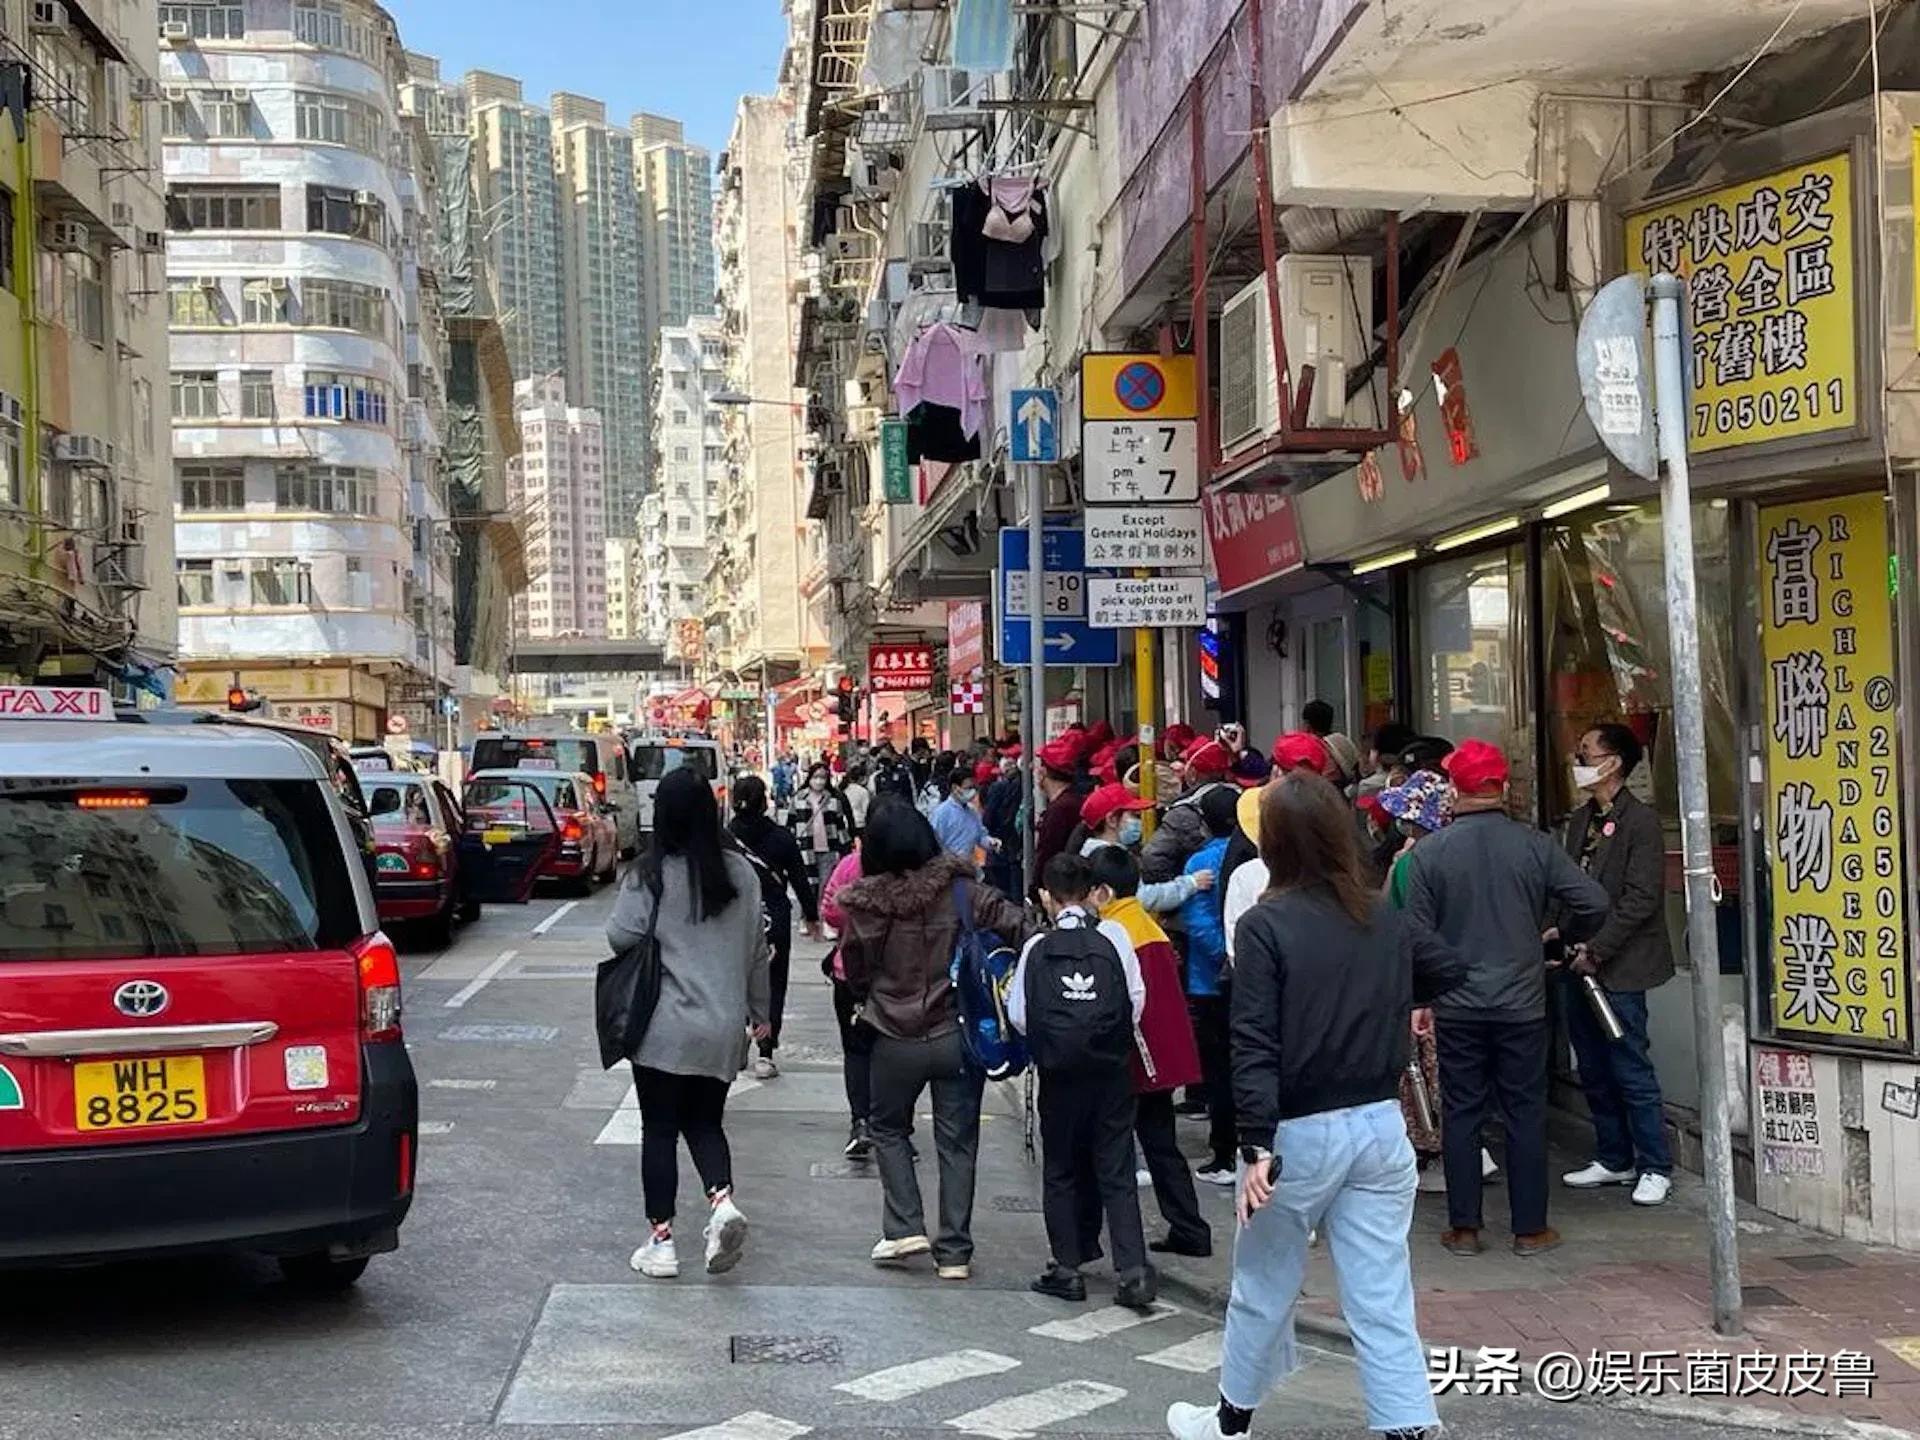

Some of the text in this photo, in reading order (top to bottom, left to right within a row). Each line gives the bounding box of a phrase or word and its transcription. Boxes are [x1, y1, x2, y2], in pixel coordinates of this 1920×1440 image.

[1643, 174, 1833, 274] 特快成交
[1690, 237, 1834, 327] 營全區
[1112, 426, 1133, 435] am
[1106, 439, 1140, 453] 上午
[1158, 427, 1176, 453] 7
[1112, 468, 1133, 480] pm
[1106, 481, 1140, 496] 下午
[1158, 470, 1176, 495] 7
[1122, 514, 1165, 527] Except
[1091, 527, 1197, 540] General Holidays
[1115, 582, 1180, 594] Except taxi
[1101, 594, 1125, 607] pick
[1176, 593, 1193, 604] off
[1767, 518, 1841, 1025] 富聯物業
[113, 1060, 168, 1093] WH
[87, 1089, 199, 1126] 8825
